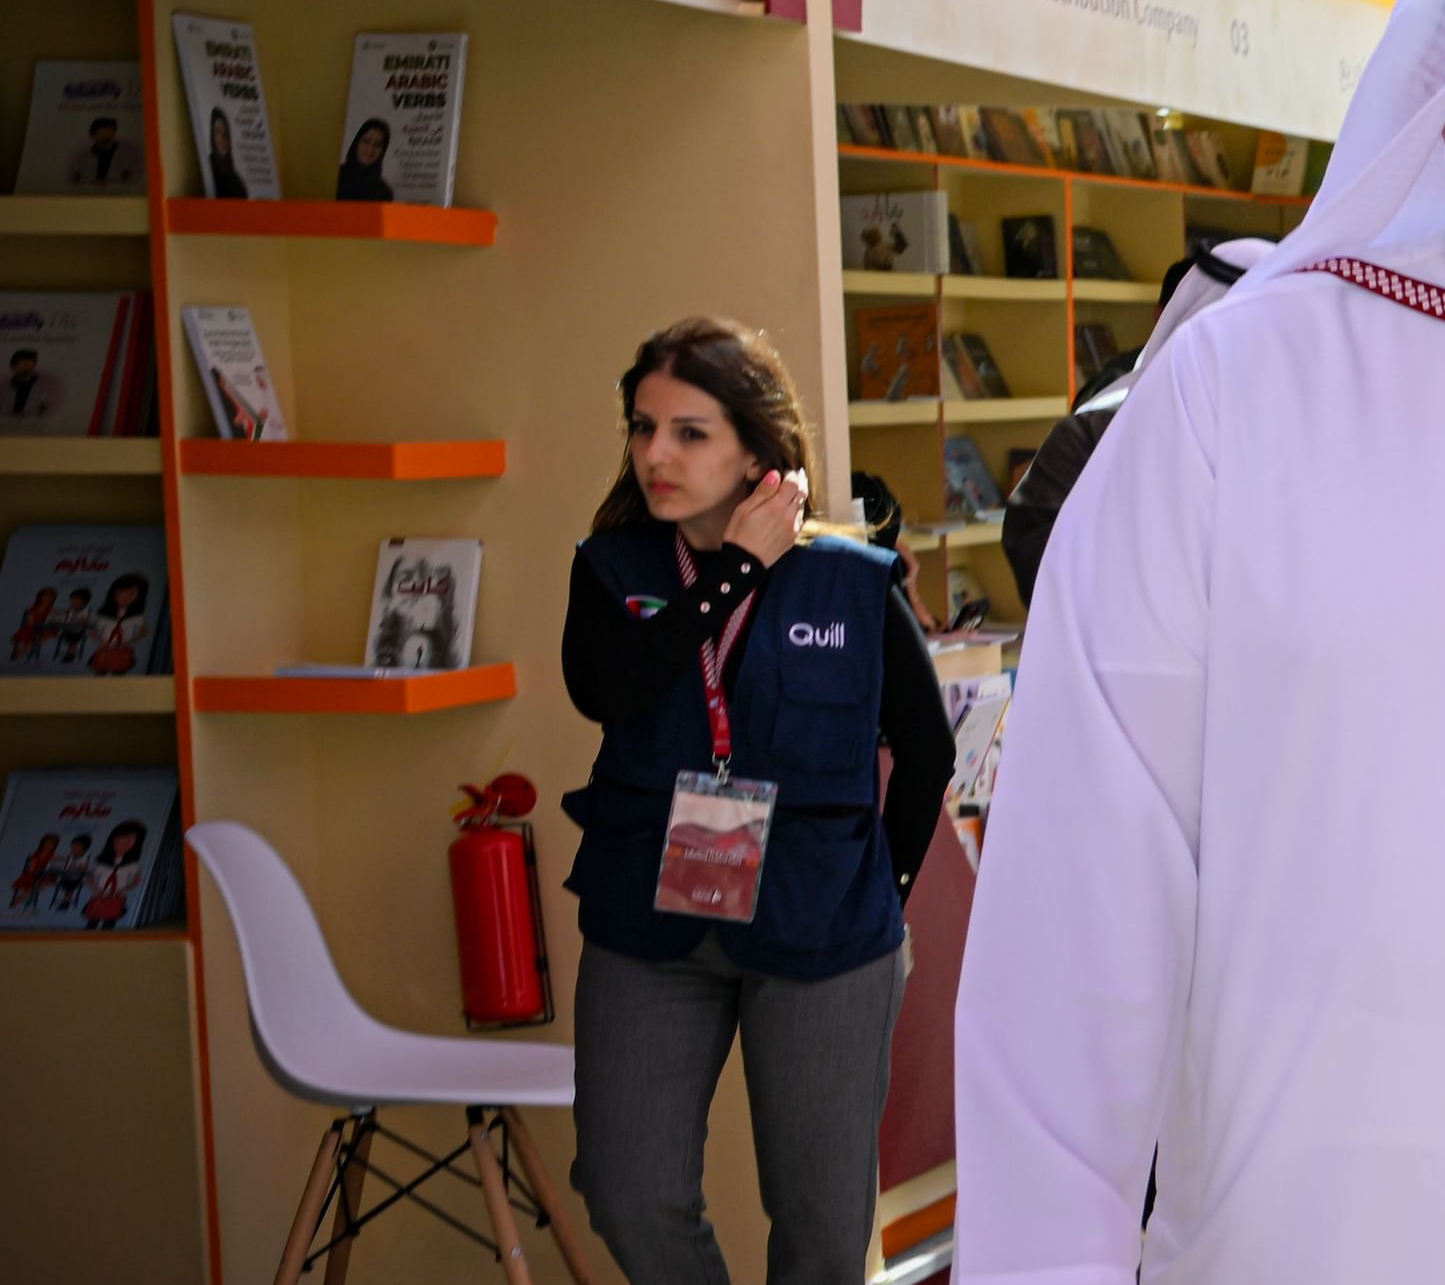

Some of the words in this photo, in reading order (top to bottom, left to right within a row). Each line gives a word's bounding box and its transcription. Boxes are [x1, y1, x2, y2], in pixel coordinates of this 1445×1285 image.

[1229, 19, 1249, 57] 03
[383, 53, 450, 72] EMIRATI
[385, 72, 448, 91] ARABIC
[392, 91, 447, 110] VERBS
[788, 621, 845, 648] Quill
